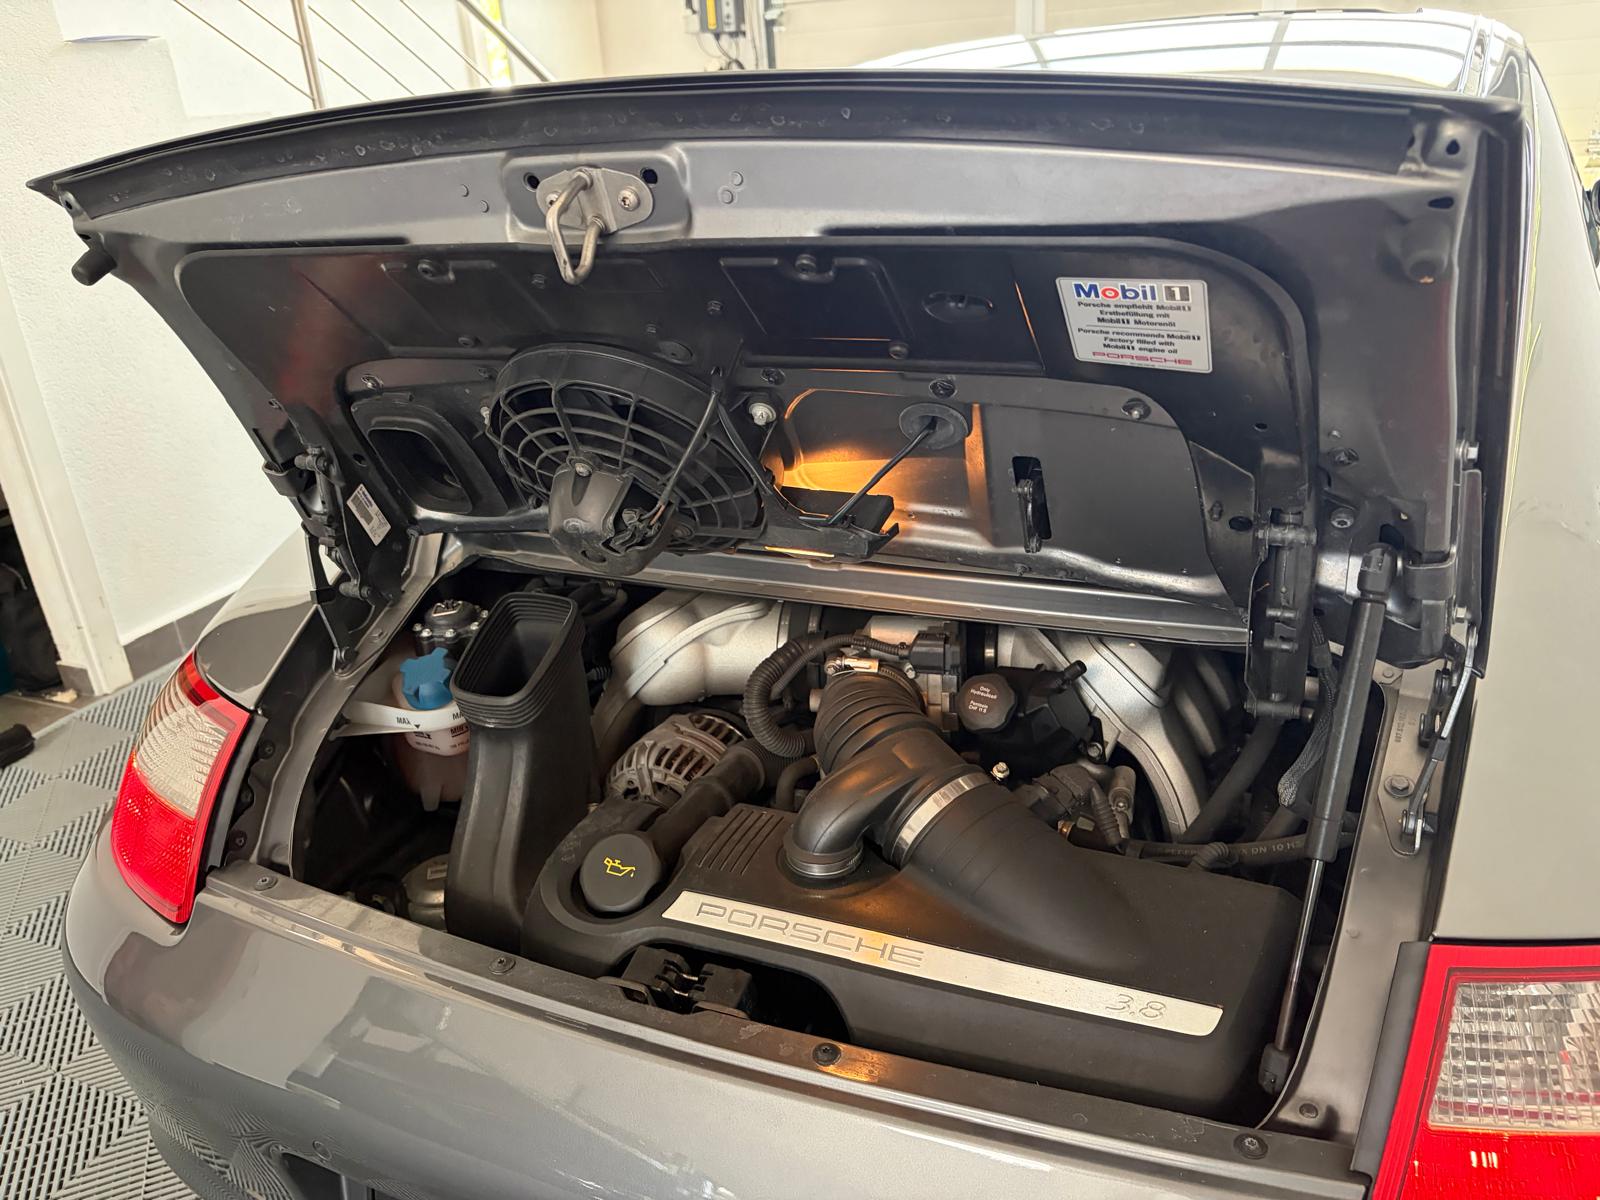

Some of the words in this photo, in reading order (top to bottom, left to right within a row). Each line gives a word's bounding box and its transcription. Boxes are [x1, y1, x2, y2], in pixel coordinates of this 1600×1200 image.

[1073, 283, 1157, 301] Mobil
[1077, 301, 1111, 309] Porsche
[1114, 303, 1153, 311] empfiehlt
[1099, 310, 1154, 319] Erstbefüllung
[1133, 319, 1176, 327] Motorenöl
[1077, 327, 1110, 335] Porsche
[1112, 331, 1165, 339] recommends
[1103, 336, 1134, 345] Factory
[1092, 351, 1193, 366] PORSCHE
[396, 716, 412, 725] MAX
[452, 711, 464, 720] MA
[1251, 846, 1267, 856] DN
[695, 901, 925, 968] PORSCHE
[1104, 993, 1167, 1019] 3.8
